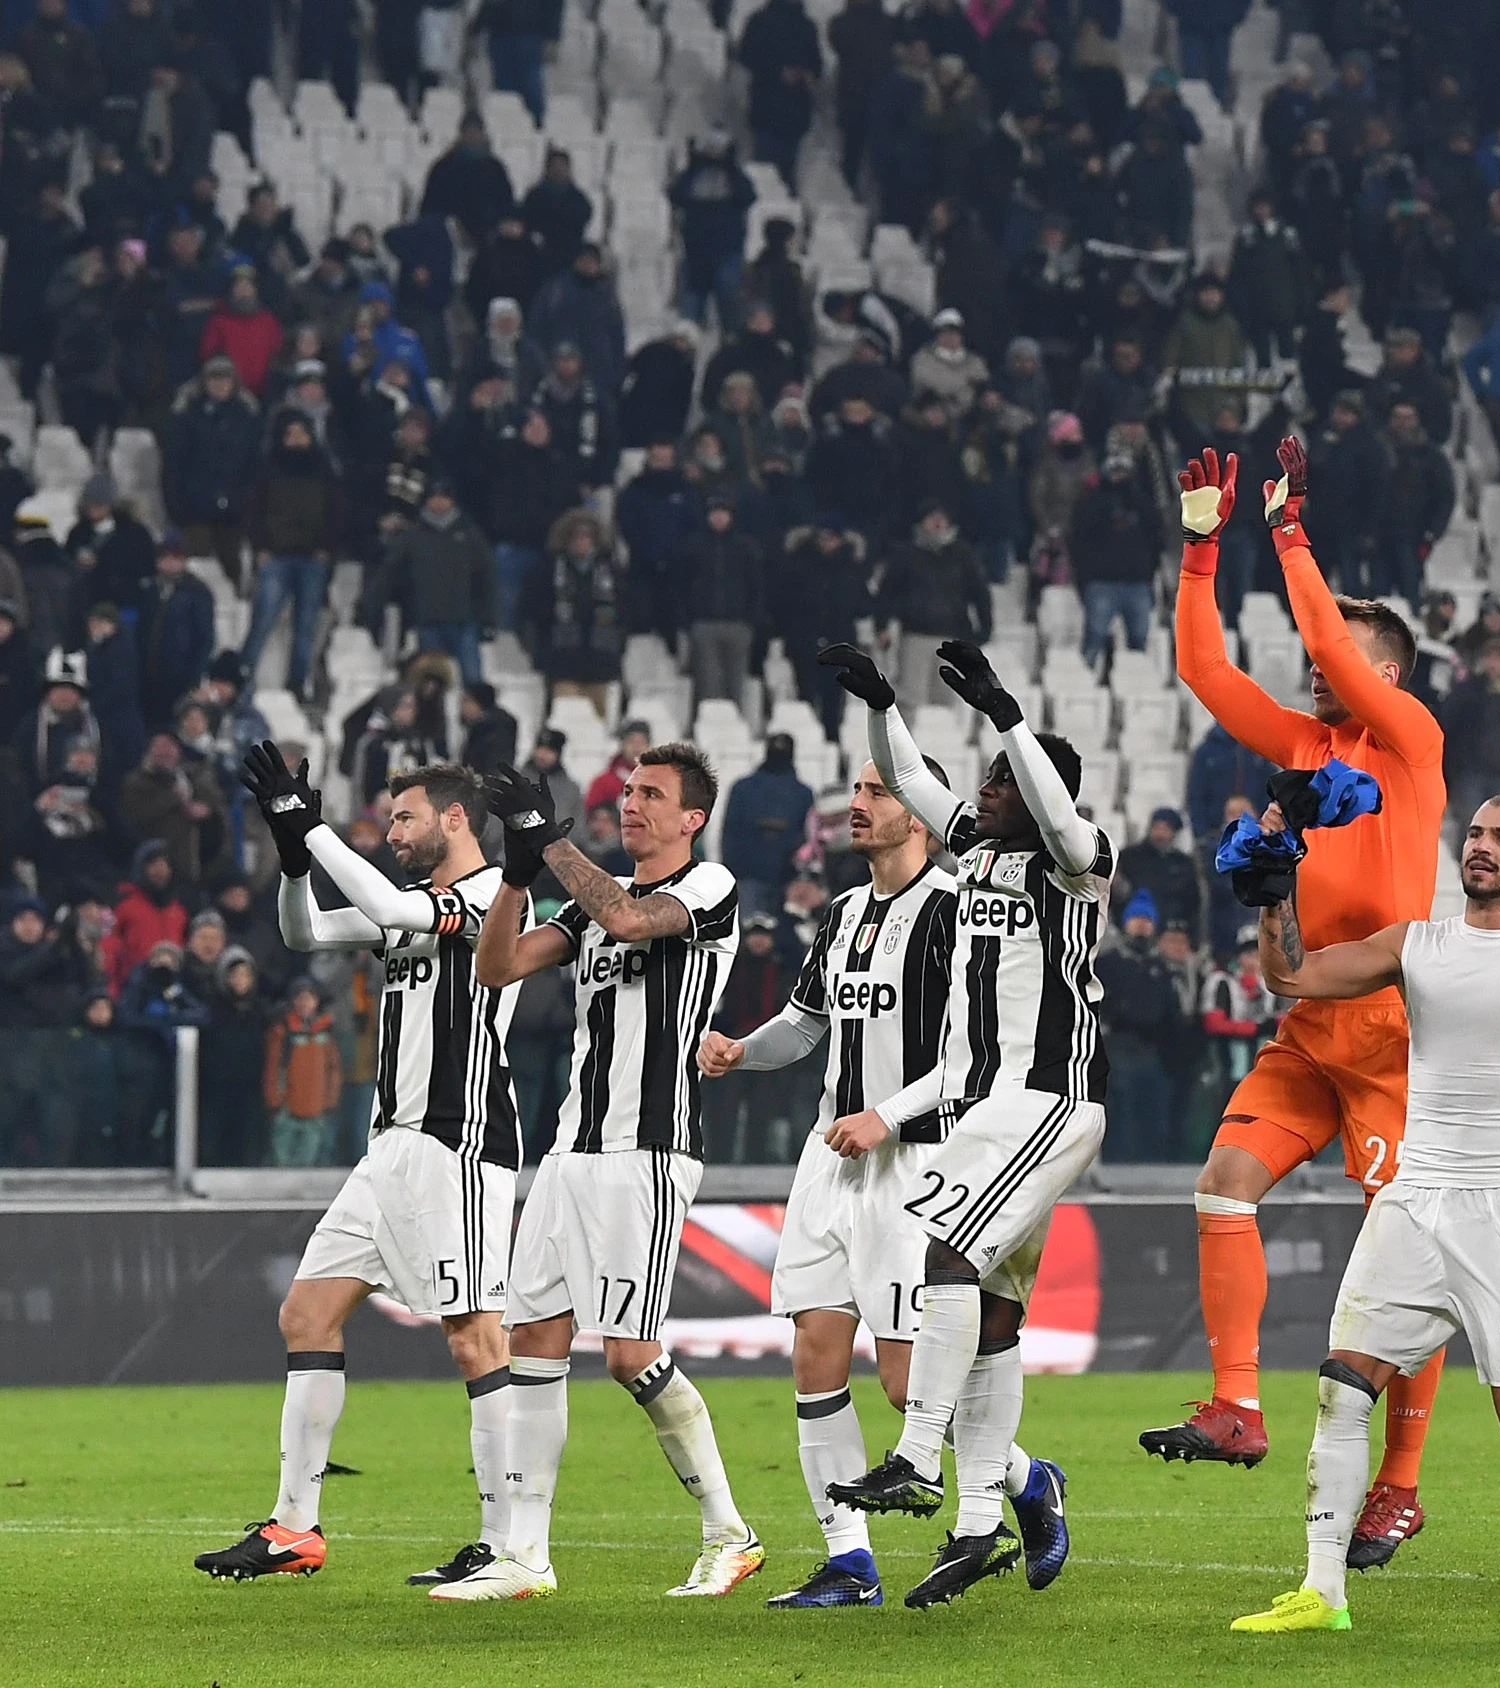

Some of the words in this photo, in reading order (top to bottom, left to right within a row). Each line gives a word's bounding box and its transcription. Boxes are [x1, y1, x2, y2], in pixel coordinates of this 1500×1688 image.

[959, 888, 1034, 936] Jeep
[385, 955, 432, 990] eep
[579, 947, 650, 985] Jeep
[828, 973, 897, 1018] Jeep
[1364, 1135, 1405, 1187] 2
[903, 1170, 970, 1227] 22
[600, 1275, 636, 1325] 17
[906, 1399, 924, 1408] VE
[1391, 1406, 1428, 1418] JUVE
[506, 1472, 523, 1482] VE
[480, 1493, 496, 1503] VE
